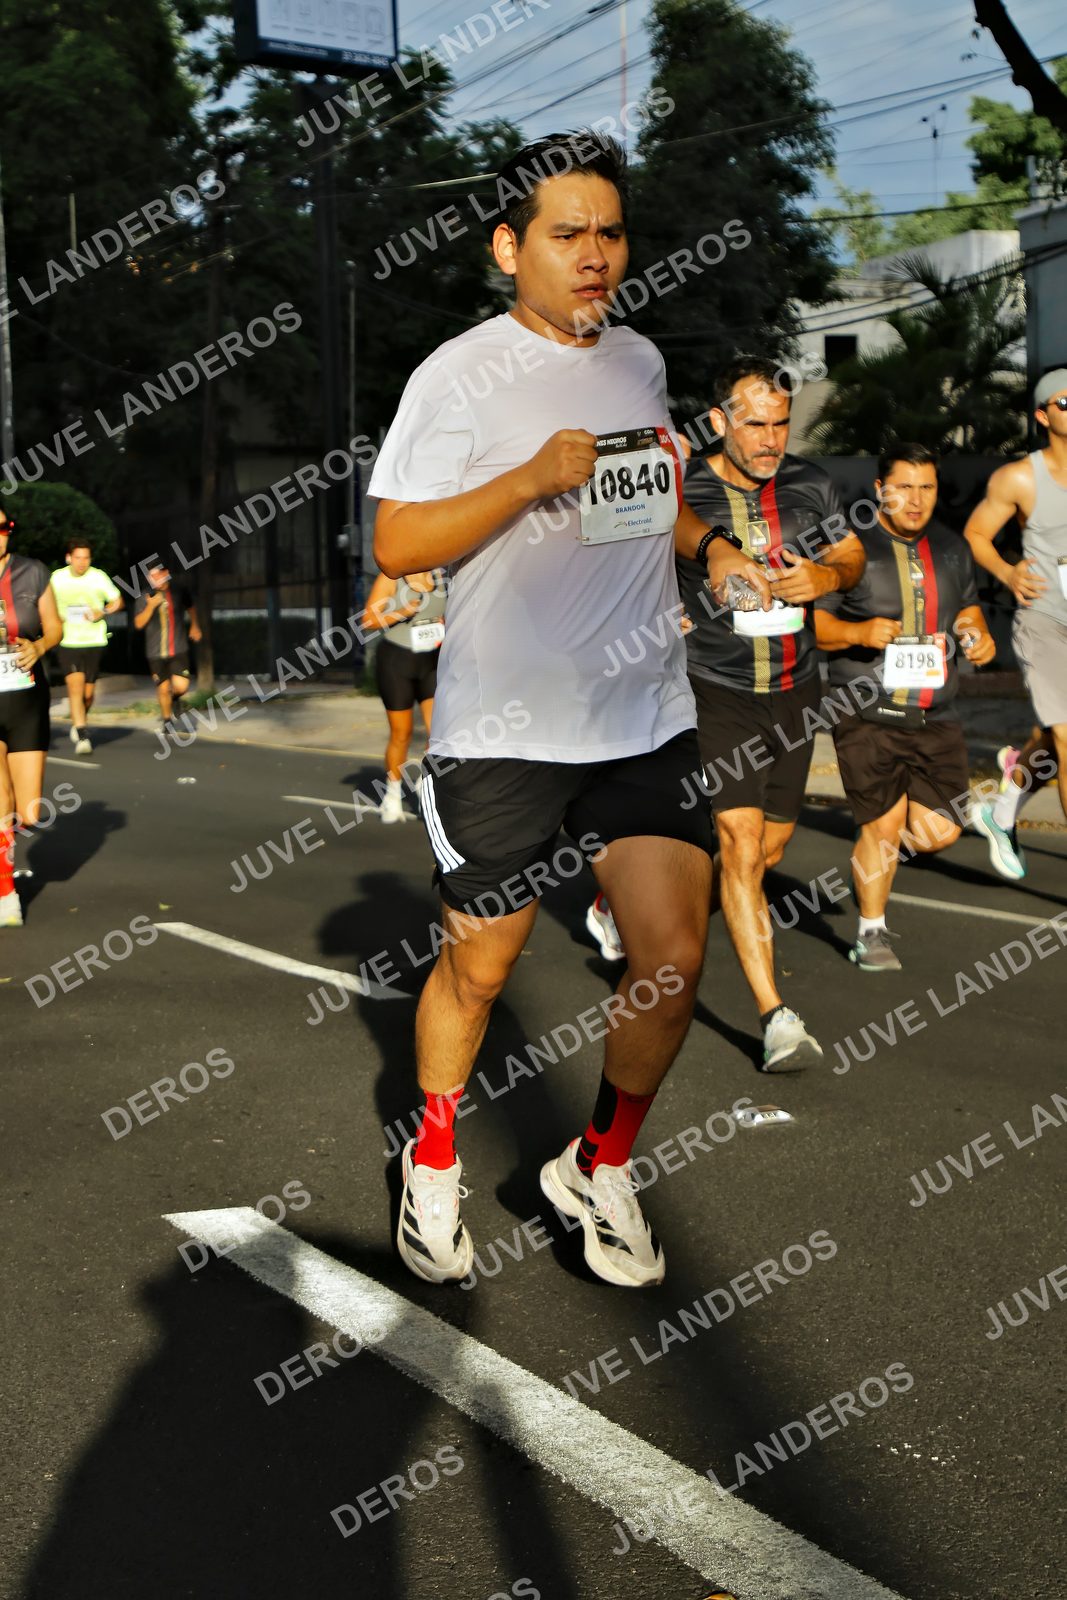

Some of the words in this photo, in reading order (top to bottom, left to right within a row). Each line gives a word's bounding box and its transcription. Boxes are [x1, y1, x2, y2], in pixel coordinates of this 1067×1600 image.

[588, 461, 670, 505] 10840
[616, 504, 646, 514] BRANDON
[896, 652, 935, 668] 8198
